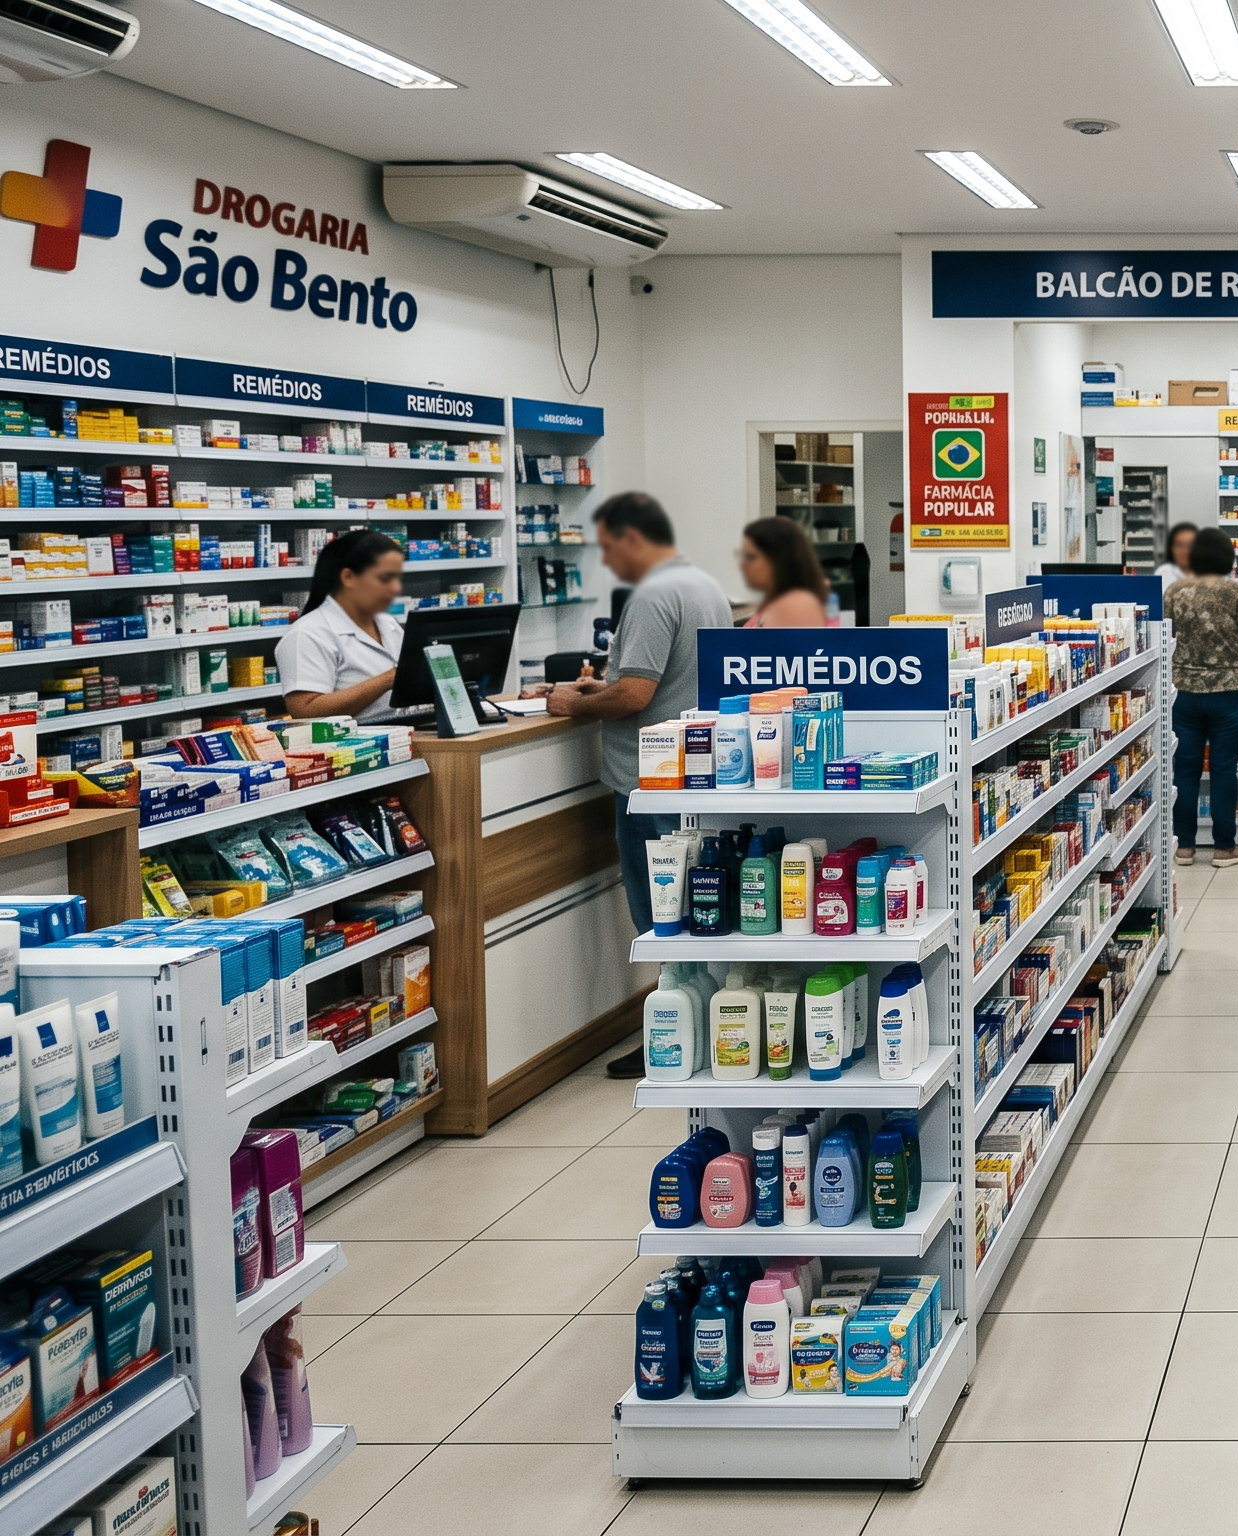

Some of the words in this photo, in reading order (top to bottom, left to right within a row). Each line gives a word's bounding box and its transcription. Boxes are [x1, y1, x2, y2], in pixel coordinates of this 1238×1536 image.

[193, 178, 369, 255] DROGARIA
[140, 219, 259, 303] São
[271, 249, 418, 332] Bento
[1036, 265, 1163, 298] BALCÃO
[1171, 271, 1213, 298] DE
[233, 373, 322, 401] REMÉDIOS
[407, 394, 474, 418] REMÉDIOS
[924, 482, 994, 500] FARMÁCIA
[924, 501, 995, 517] POPULAR
[723, 648, 923, 686] REMÉDIOS
